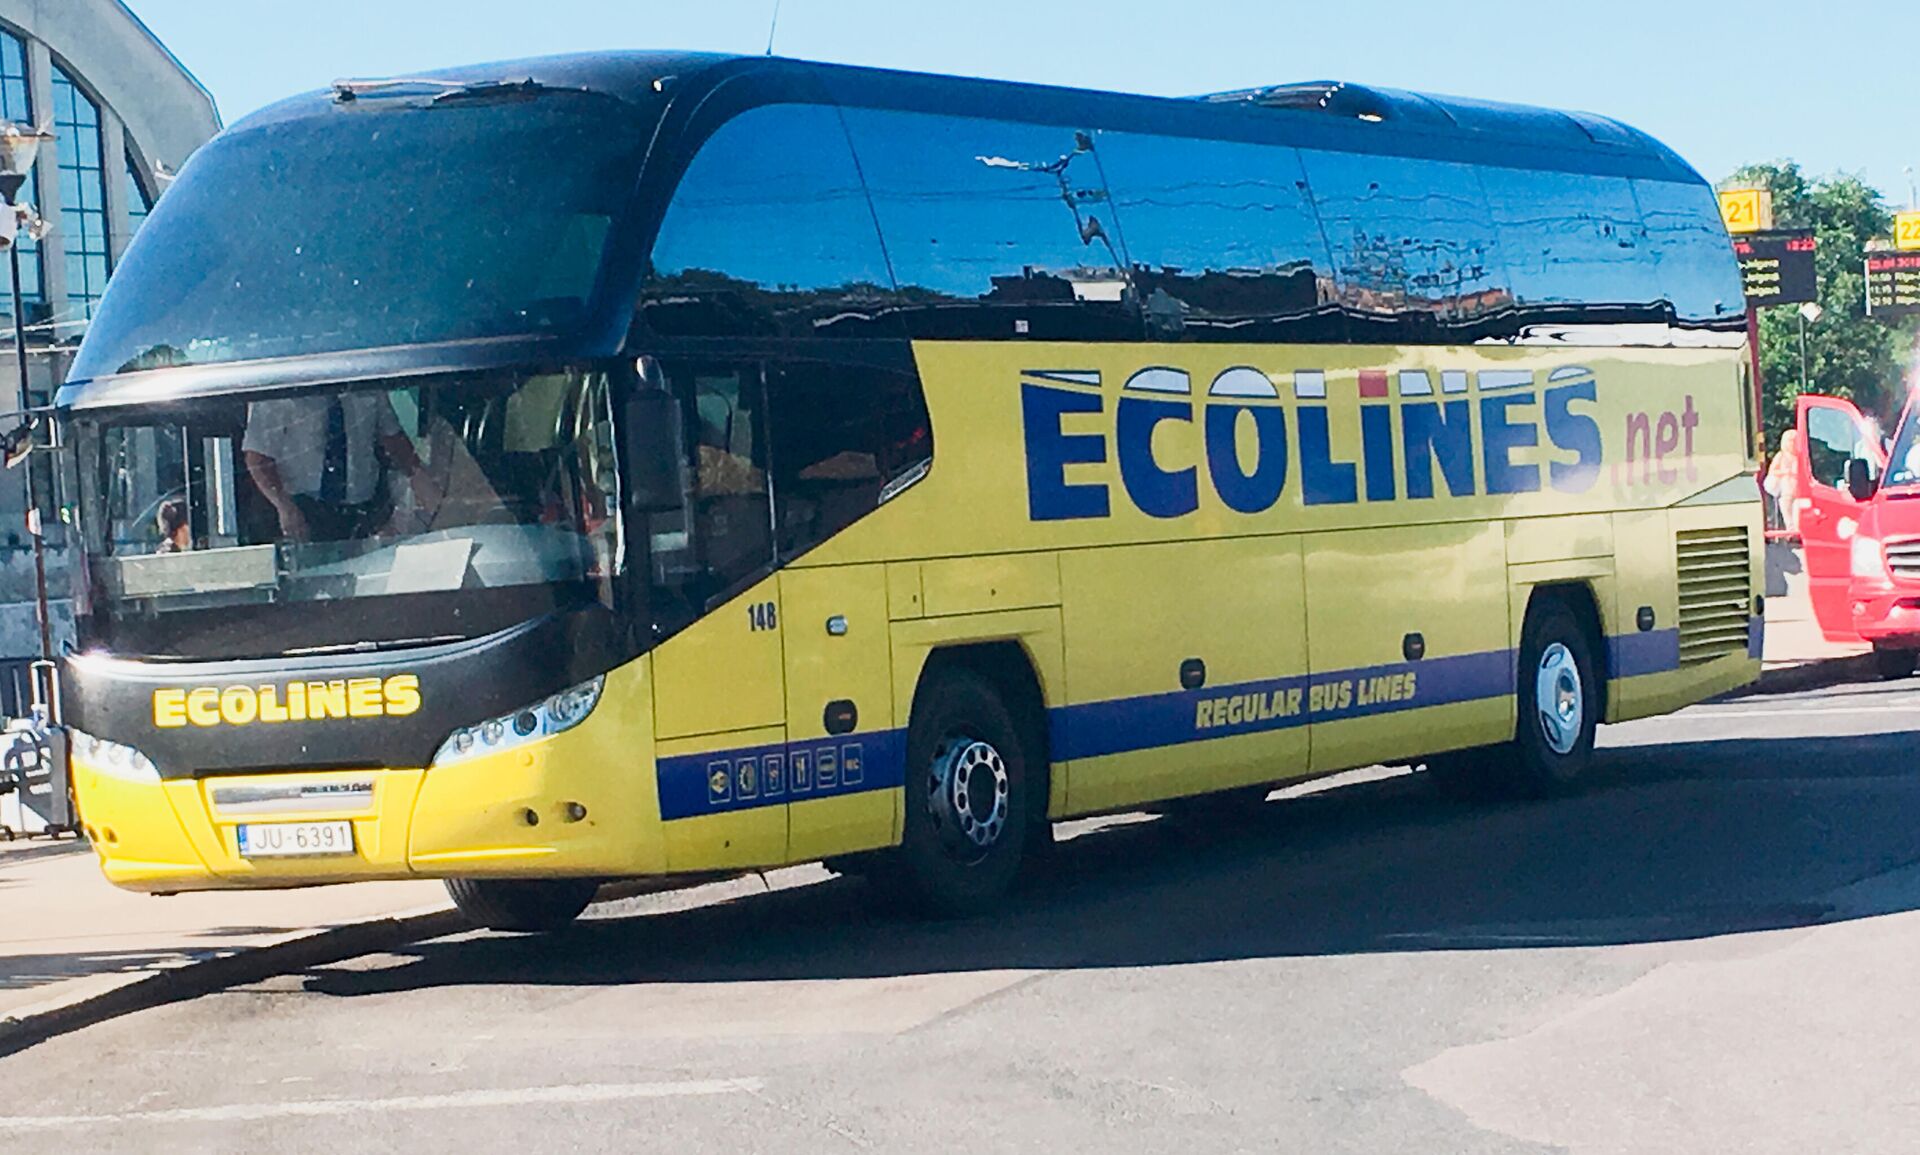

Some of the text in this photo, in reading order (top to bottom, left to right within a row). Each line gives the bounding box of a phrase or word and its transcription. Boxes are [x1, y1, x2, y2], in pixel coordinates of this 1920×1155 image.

[1728, 200, 1754, 222] 21
[1020, 365, 1603, 521] ECOLINES
[748, 602, 776, 631] 148
[153, 675, 421, 728] ECOLINES
[1195, 672, 1416, 729] REGULAR BUS LINES
[255, 826, 347, 849] JU-6391
